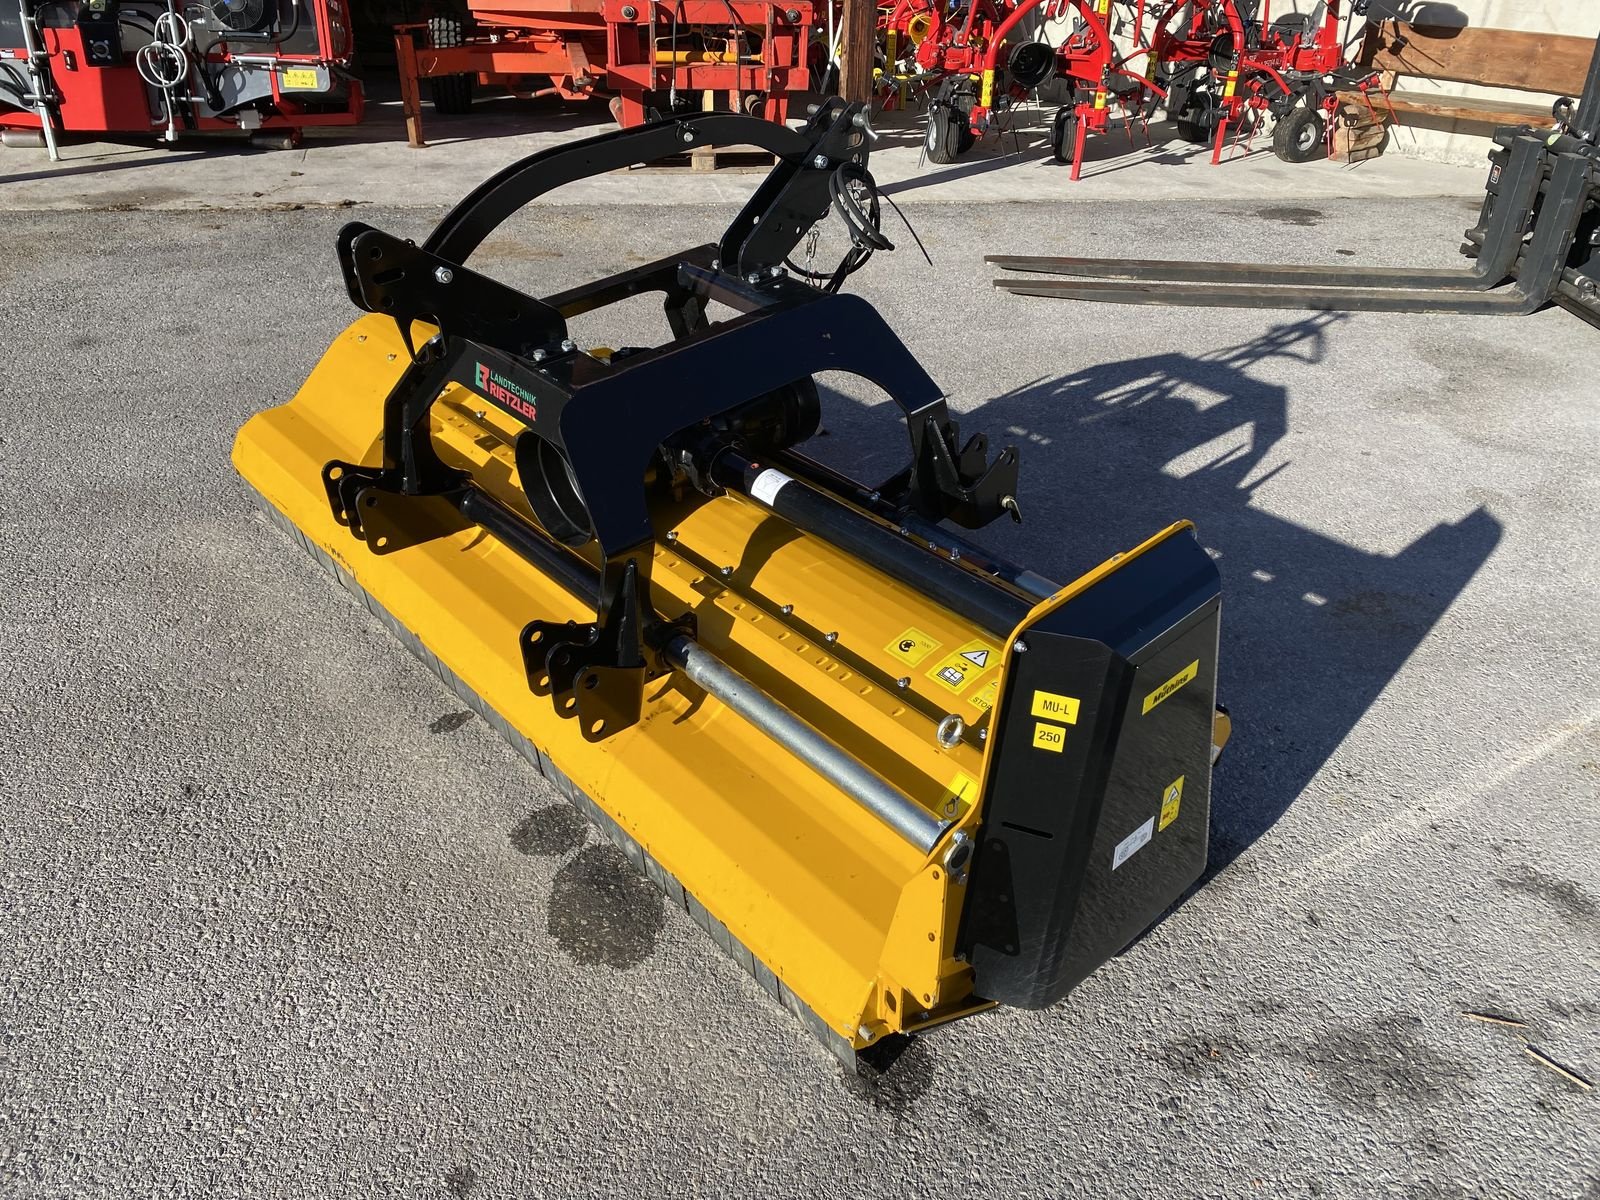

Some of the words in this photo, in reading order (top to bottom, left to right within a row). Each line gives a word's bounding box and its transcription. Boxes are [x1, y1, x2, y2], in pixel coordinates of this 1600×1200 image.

[490, 370, 537, 406] LANDTECHNIK
[489, 380, 536, 422] RIETZLER
[1042, 700, 1070, 715] MU-L
[1038, 730, 1061, 743] 250
